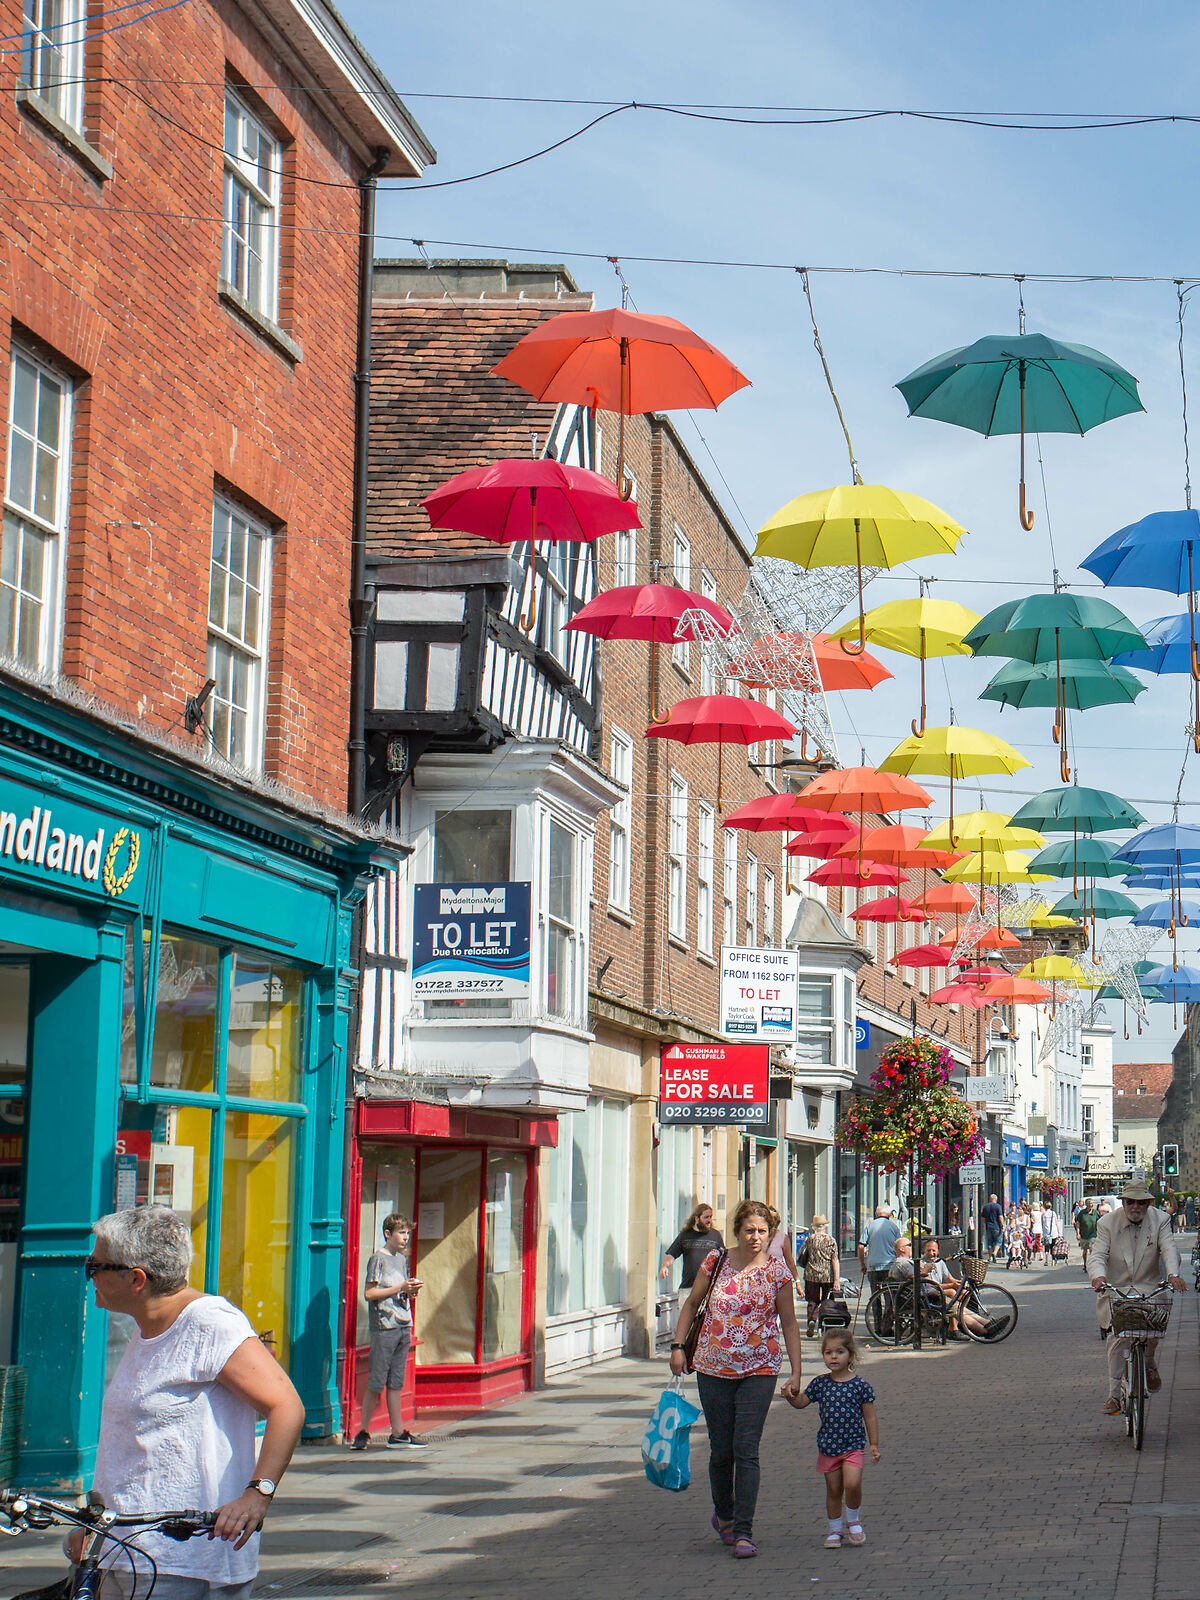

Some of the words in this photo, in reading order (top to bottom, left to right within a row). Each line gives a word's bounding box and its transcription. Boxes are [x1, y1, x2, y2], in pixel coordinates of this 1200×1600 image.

[427, 922, 462, 949] TO
[470, 921, 517, 947] LET
[432, 948, 450, 956] Due
[453, 948, 462, 956] to
[464, 947, 509, 956] relocation
[729, 952, 761, 963] OFFICE
[763, 955, 789, 965] SUITE
[723, 969, 749, 979] FROM
[752, 971, 771, 981] 1162
[773, 972, 795, 982] SQFT
[415, 981, 452, 989] 01722
[457, 980, 504, 988] 337577
[739, 987, 755, 999] TO
[758, 989, 781, 1001] LET
[665, 1069, 709, 1081] LEASE
[665, 1083, 703, 1099] FOR
[708, 1083, 754, 1099] SALE
[665, 1107, 691, 1117] 020
[694, 1107, 726, 1117] 3296
[729, 1107, 764, 1117] 2000
